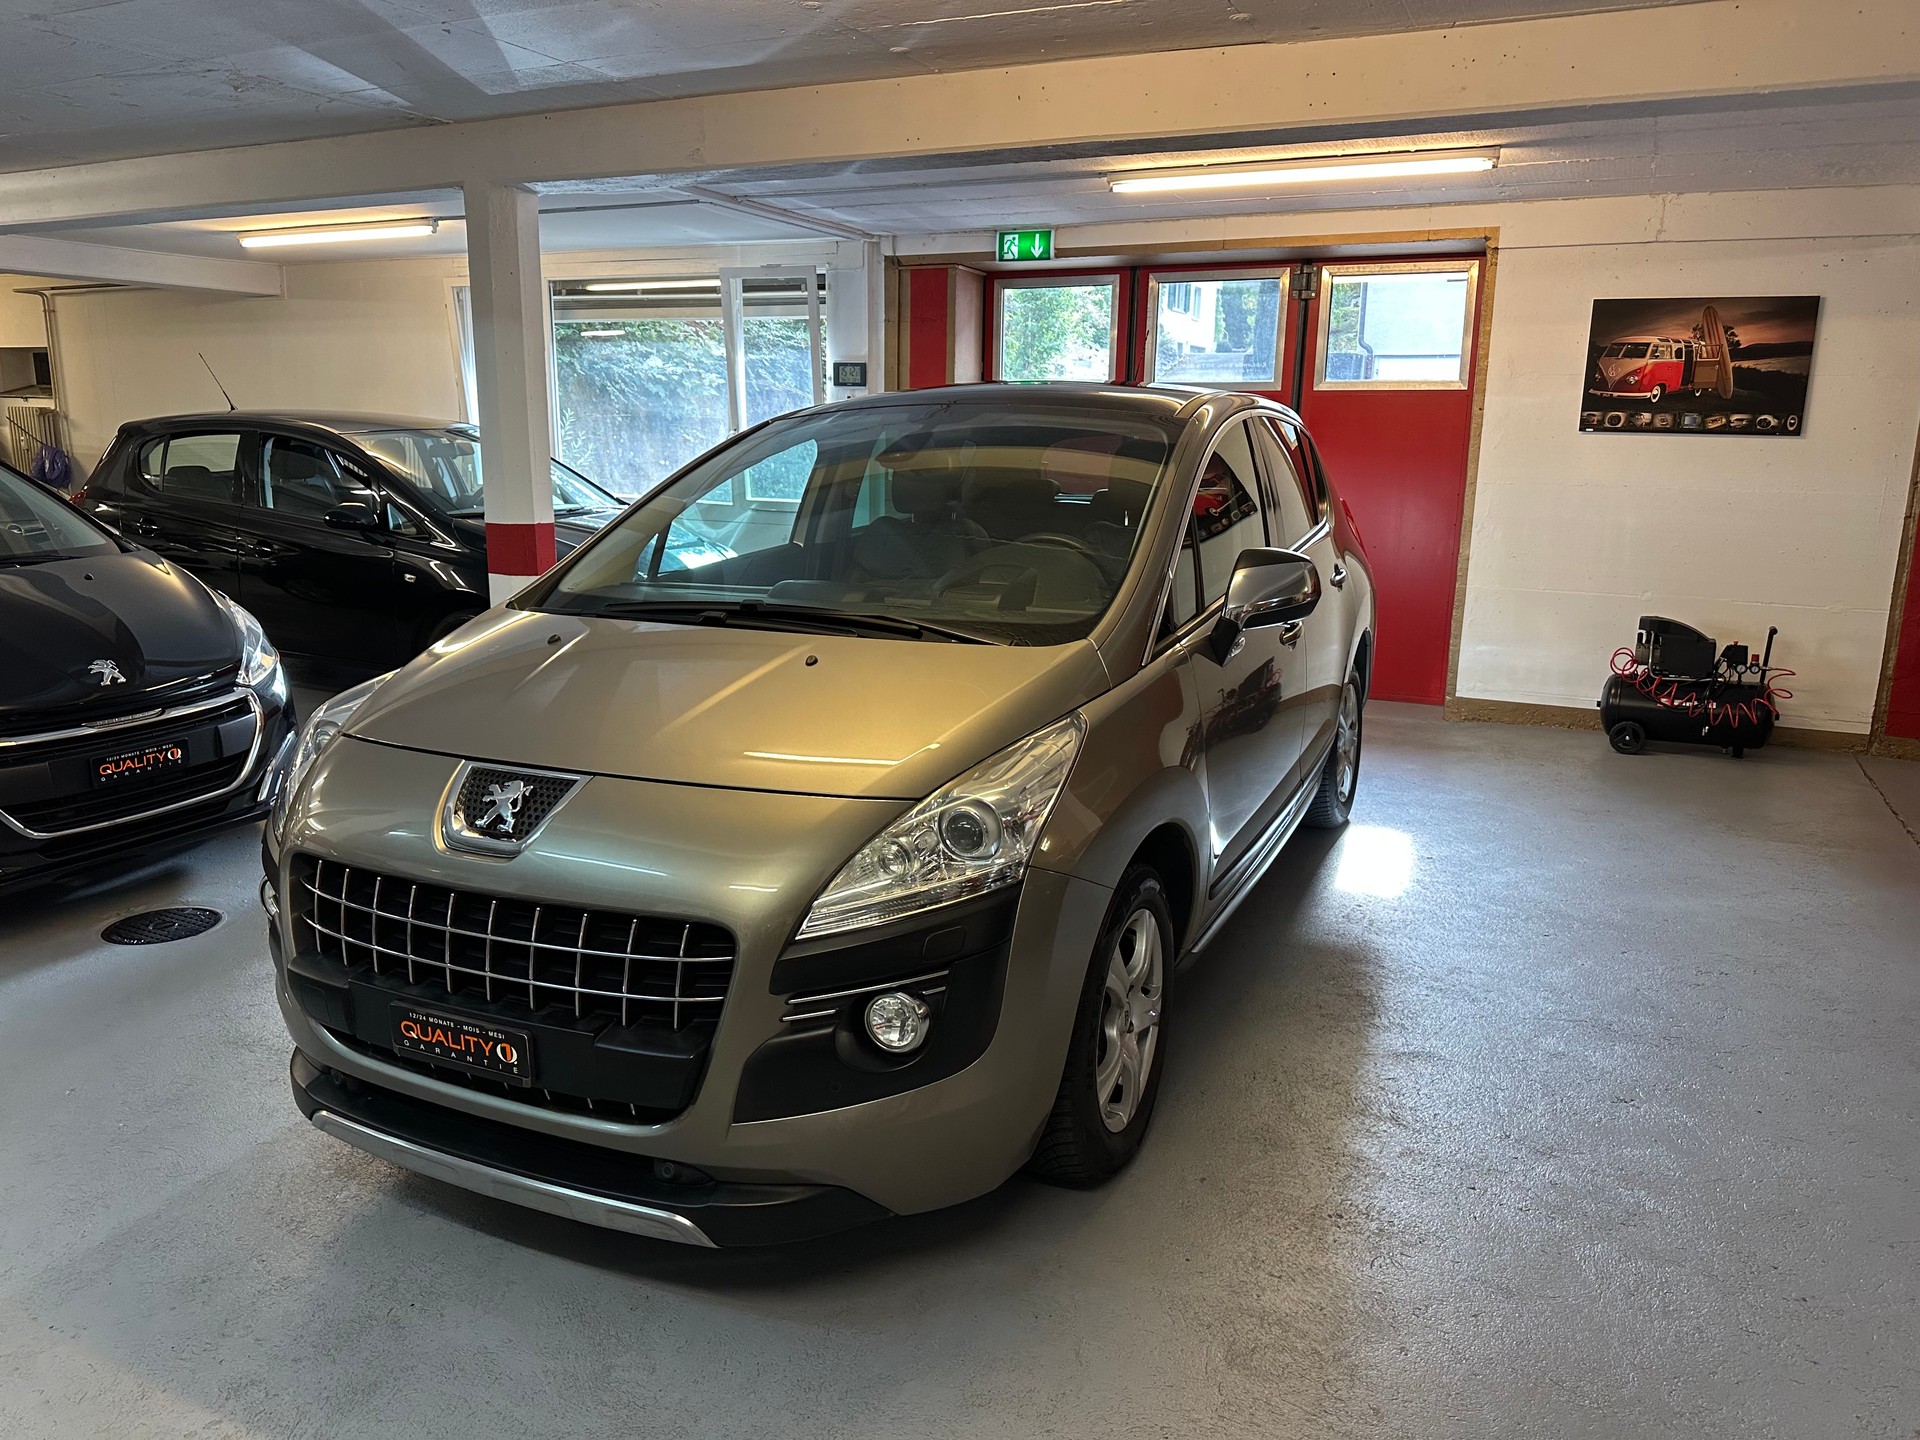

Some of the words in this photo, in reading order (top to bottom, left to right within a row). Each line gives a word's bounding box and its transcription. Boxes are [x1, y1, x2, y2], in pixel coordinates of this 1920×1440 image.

[99, 751, 166, 775] QUALITY
[400, 1020, 494, 1057] QUALITY
[409, 1012, 427, 1021] 12/24
[428, 1016, 455, 1028] MONATE
[462, 1024, 480, 1034] MOIS
[488, 1030, 505, 1040] MESI
[403, 1039, 519, 1074] GARANTIE
